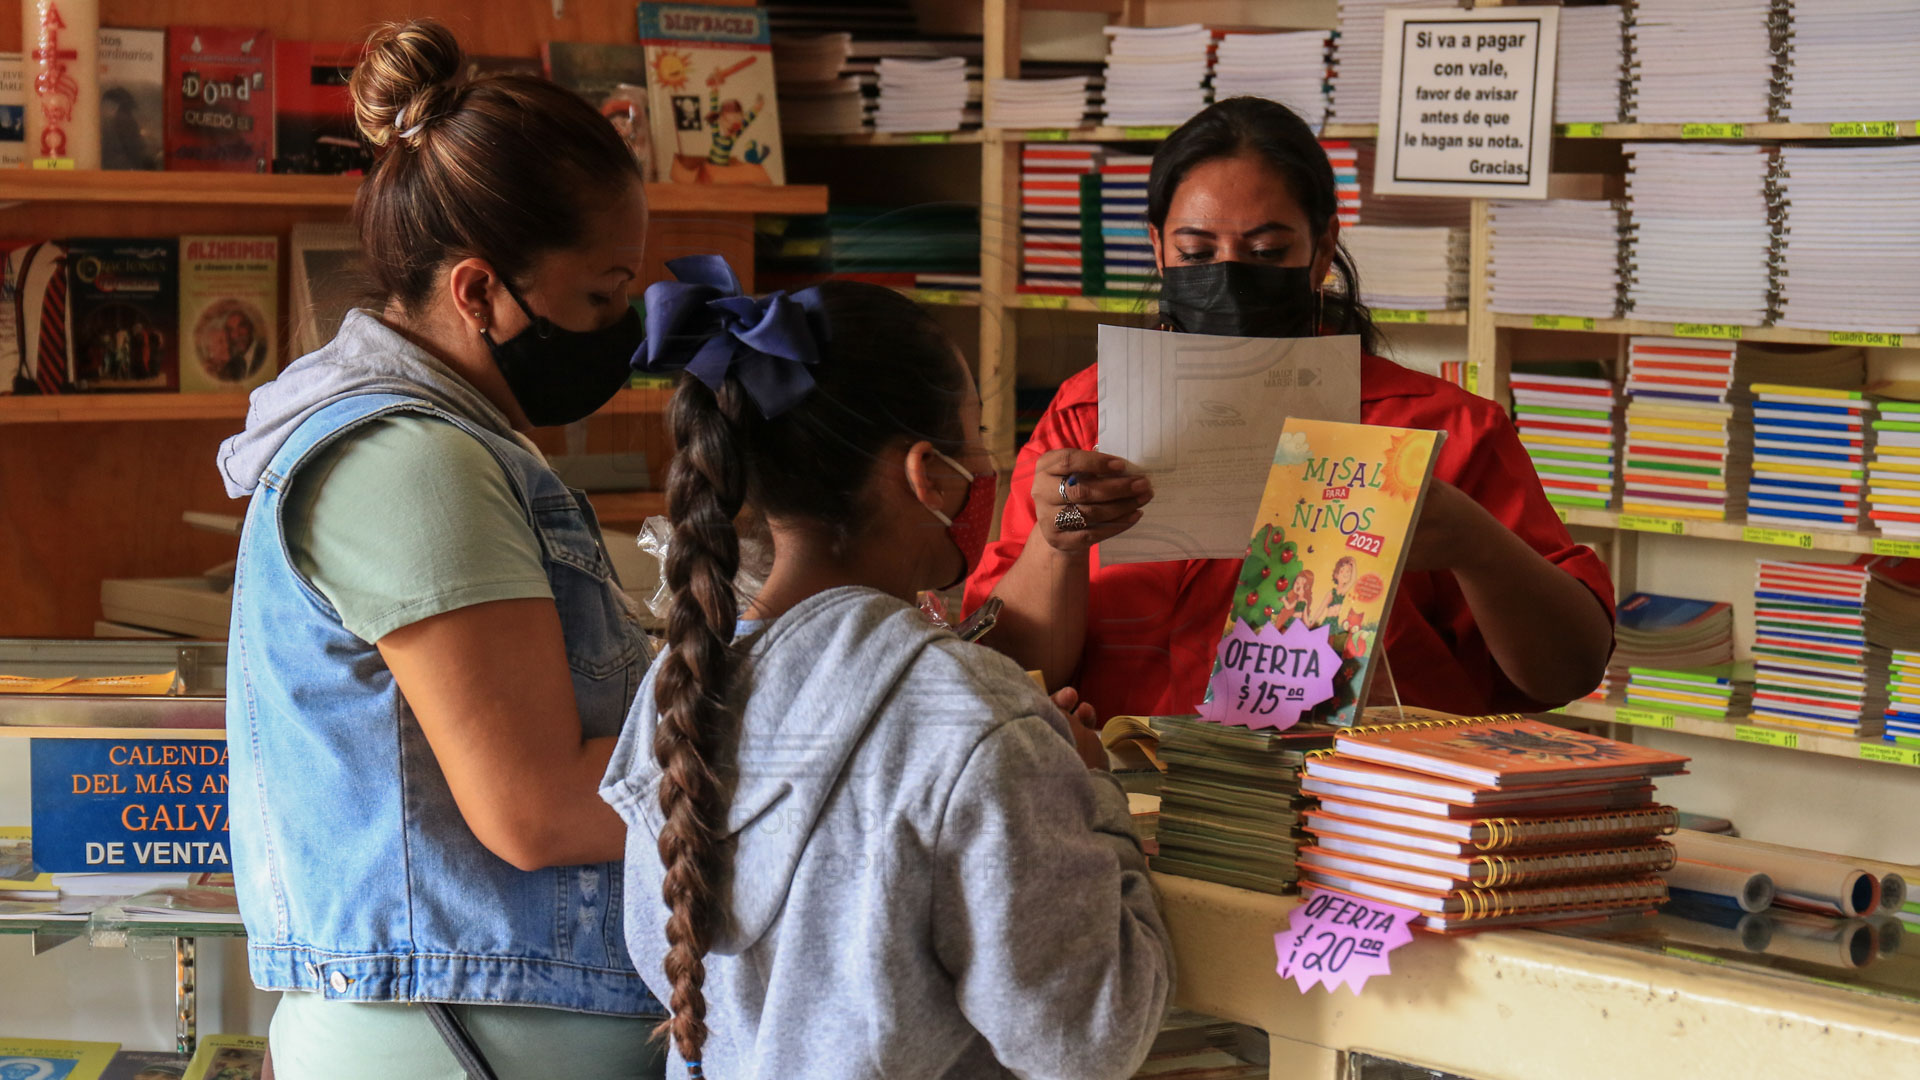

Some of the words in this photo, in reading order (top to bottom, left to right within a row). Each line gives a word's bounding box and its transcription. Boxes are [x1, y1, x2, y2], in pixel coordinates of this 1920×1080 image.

[1416, 31, 1432, 49] Si
[1437, 34, 1456, 48] va
[1461, 34, 1471, 48] a
[1476, 34, 1526, 52] pagar
[1433, 62, 1464, 76] con
[1469, 59, 1508, 79] vale,
[1416, 85, 1450, 101] favor
[1454, 86, 1471, 101] de
[1475, 86, 1518, 101] avisar
[1420, 111, 1458, 125] antes
[1463, 109, 1480, 125] de
[1484, 112, 1510, 128] que
[1682, 123, 1704, 136] Cuadro
[1829, 123, 1854, 135] Cuadro
[1856, 123, 1880, 136] Grnde
[1883, 122, 1895, 136] $22
[1404, 132, 1417, 147] le
[1421, 133, 1463, 151] hagan
[1467, 135, 1483, 148] su
[1488, 134, 1524, 149] nota.
[1469, 159, 1529, 175] Gracias.
[187, 242, 277, 260] ALZHEIMER
[1678, 323, 1709, 335] Cuadro
[1832, 331, 1864, 342] Cuadro
[1866, 333, 1886, 344] Gde.
[1888, 334, 1901, 347] $22
[1302, 456, 1383, 488] MISAL
[1325, 488, 1347, 499] PARA
[1290, 499, 1376, 535] NIÑOS
[1349, 533, 1381, 553] 2022
[1799, 534, 1812, 548] $20
[1224, 638, 1321, 678] OFERTA
[1662, 715, 1673, 729] $11
[1784, 734, 1797, 748] $11
[72, 774, 128, 794] DEL
[135, 770, 193, 794] MÁS
[85, 842, 125, 864] DE
[133, 842, 229, 864] VENTA
[1304, 894, 1396, 934] OFERTA
